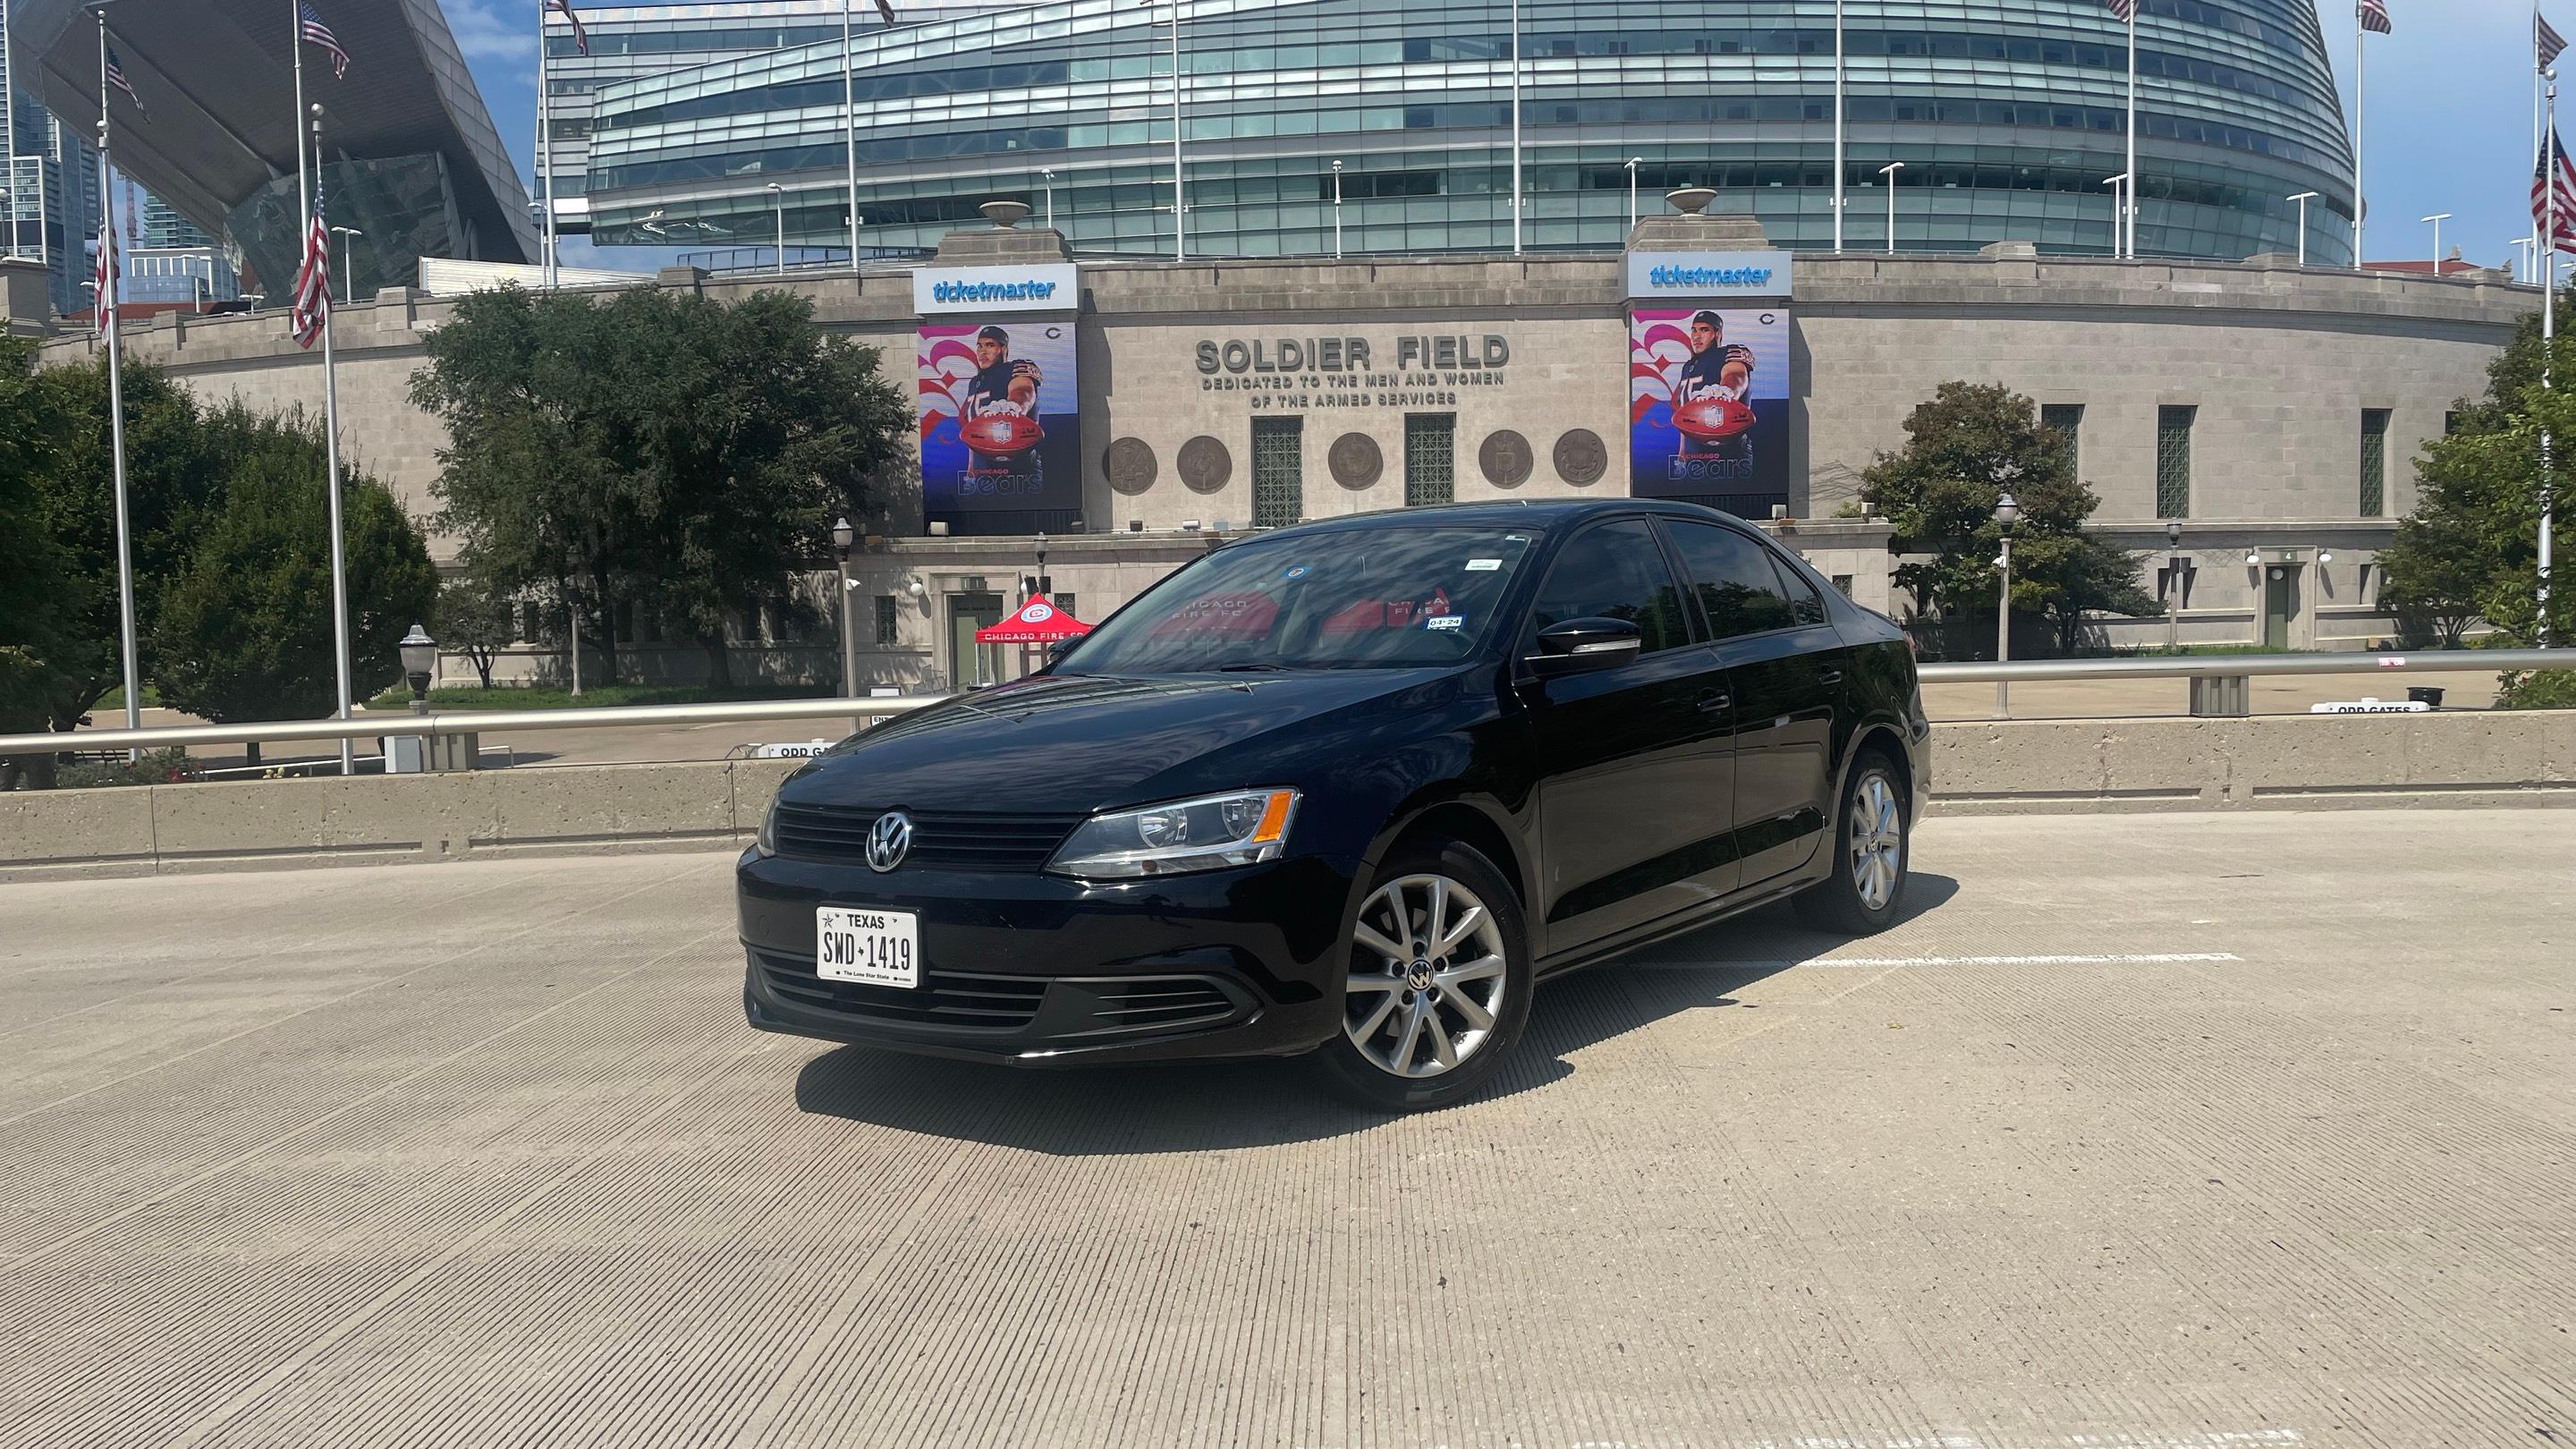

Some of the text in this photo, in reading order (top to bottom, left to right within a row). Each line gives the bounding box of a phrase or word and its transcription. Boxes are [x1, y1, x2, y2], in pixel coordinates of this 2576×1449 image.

[1649, 265, 1772, 286] ticketmaster
[933, 280, 1055, 302] ticketmaster
[1196, 335, 1509, 374] SOLDIER FIELD
[1202, 372, 1504, 390] DEDICATED TO THE MEN AND WOMEN
[1251, 392, 1456, 409] OF THE ARMED SERVICES
[1668, 454, 1753, 480] Bears
[957, 470, 1043, 496] Bears
[1173, 610, 1210, 619] FIRE
[1040, 631, 1064, 640] FIRE
[781, 748, 809, 757] ODD
[847, 913, 885, 929] TEXAS
